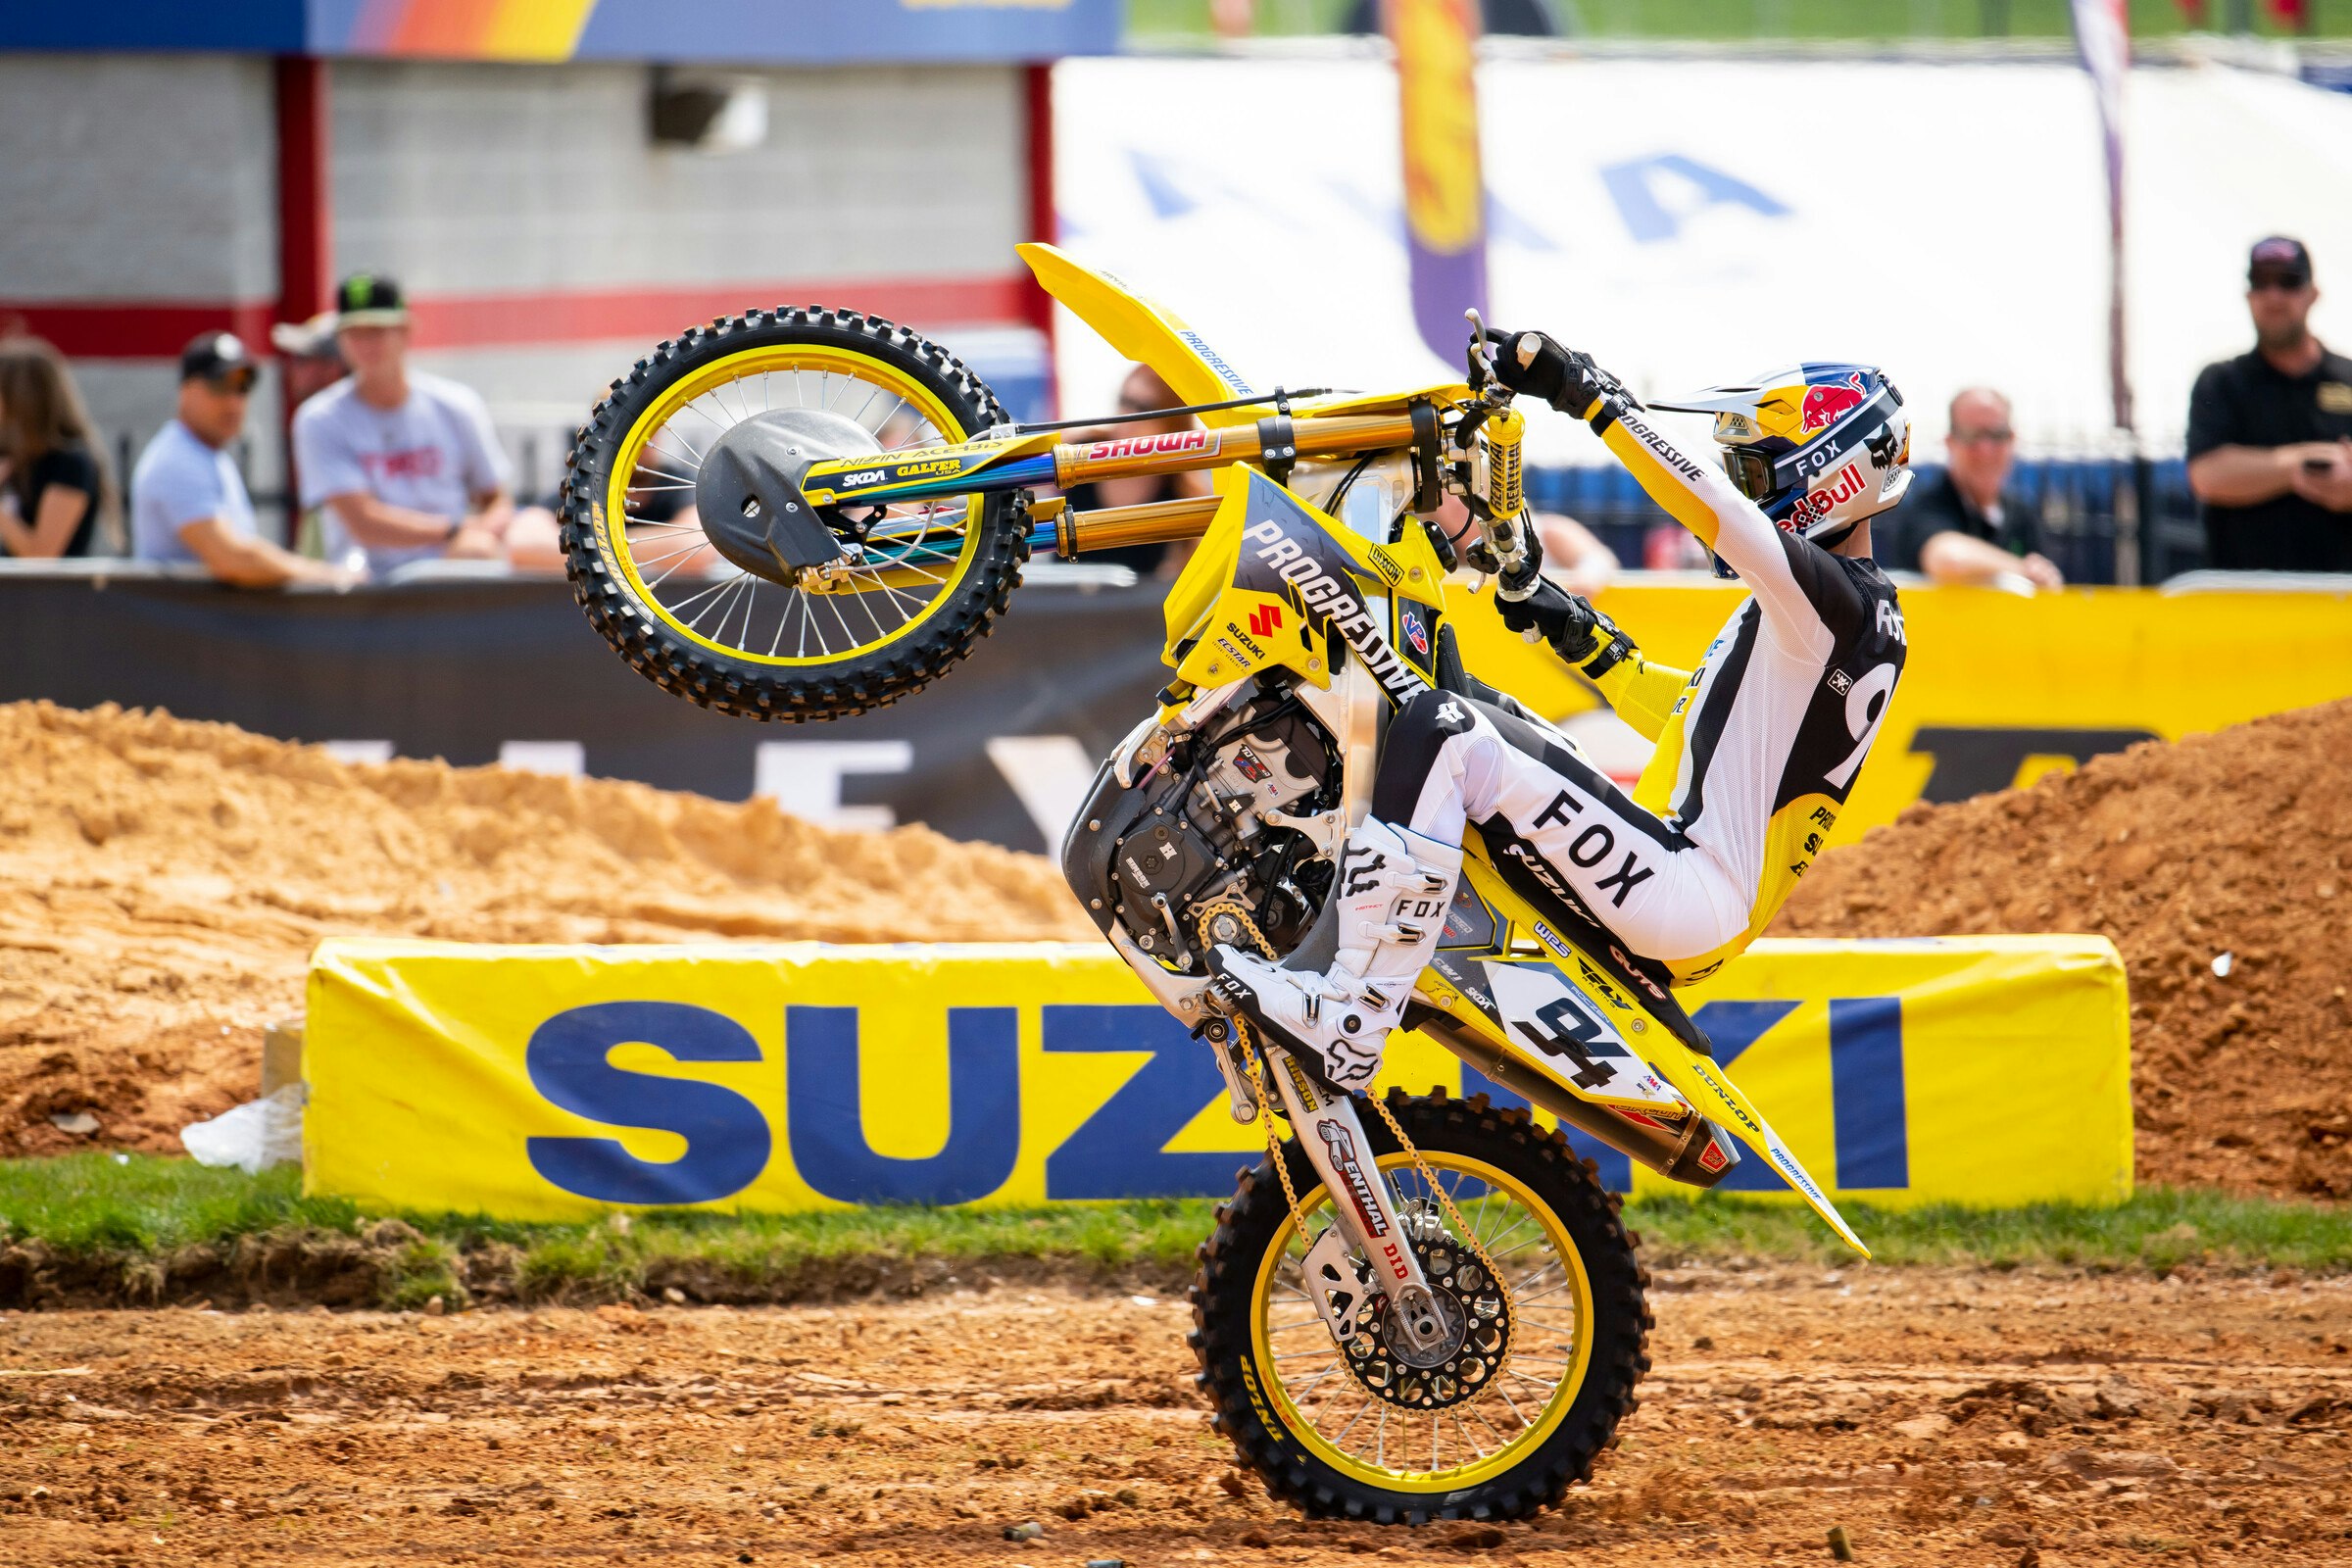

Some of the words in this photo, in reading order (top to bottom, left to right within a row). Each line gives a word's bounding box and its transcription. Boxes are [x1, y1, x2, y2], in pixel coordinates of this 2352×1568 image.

[1180, 330, 1254, 395] PROGRESSIVE
[1089, 429, 1208, 462] SHOWA
[1795, 440, 1842, 477] FOX
[897, 459, 961, 477] GALFER
[1372, 548, 1401, 582] DIXXON
[1217, 638, 1251, 667] ECSTAR
[1226, 622, 1266, 661] SUZUKI
[1532, 789, 1655, 908] FOX
[1396, 900, 1446, 918] FOX
[1533, 921, 1572, 958] WPS
[1216, 972, 1252, 1000] FOX
[1577, 956, 1635, 1011] FLY
[1609, 944, 1667, 1001] GUTS
[1570, 986, 1611, 1024] ROCZEN
[1510, 998, 1633, 1091] 94
[1692, 1063, 1760, 1133] DUNLOP
[1770, 1148, 1822, 1200] PROGRESSIVE
